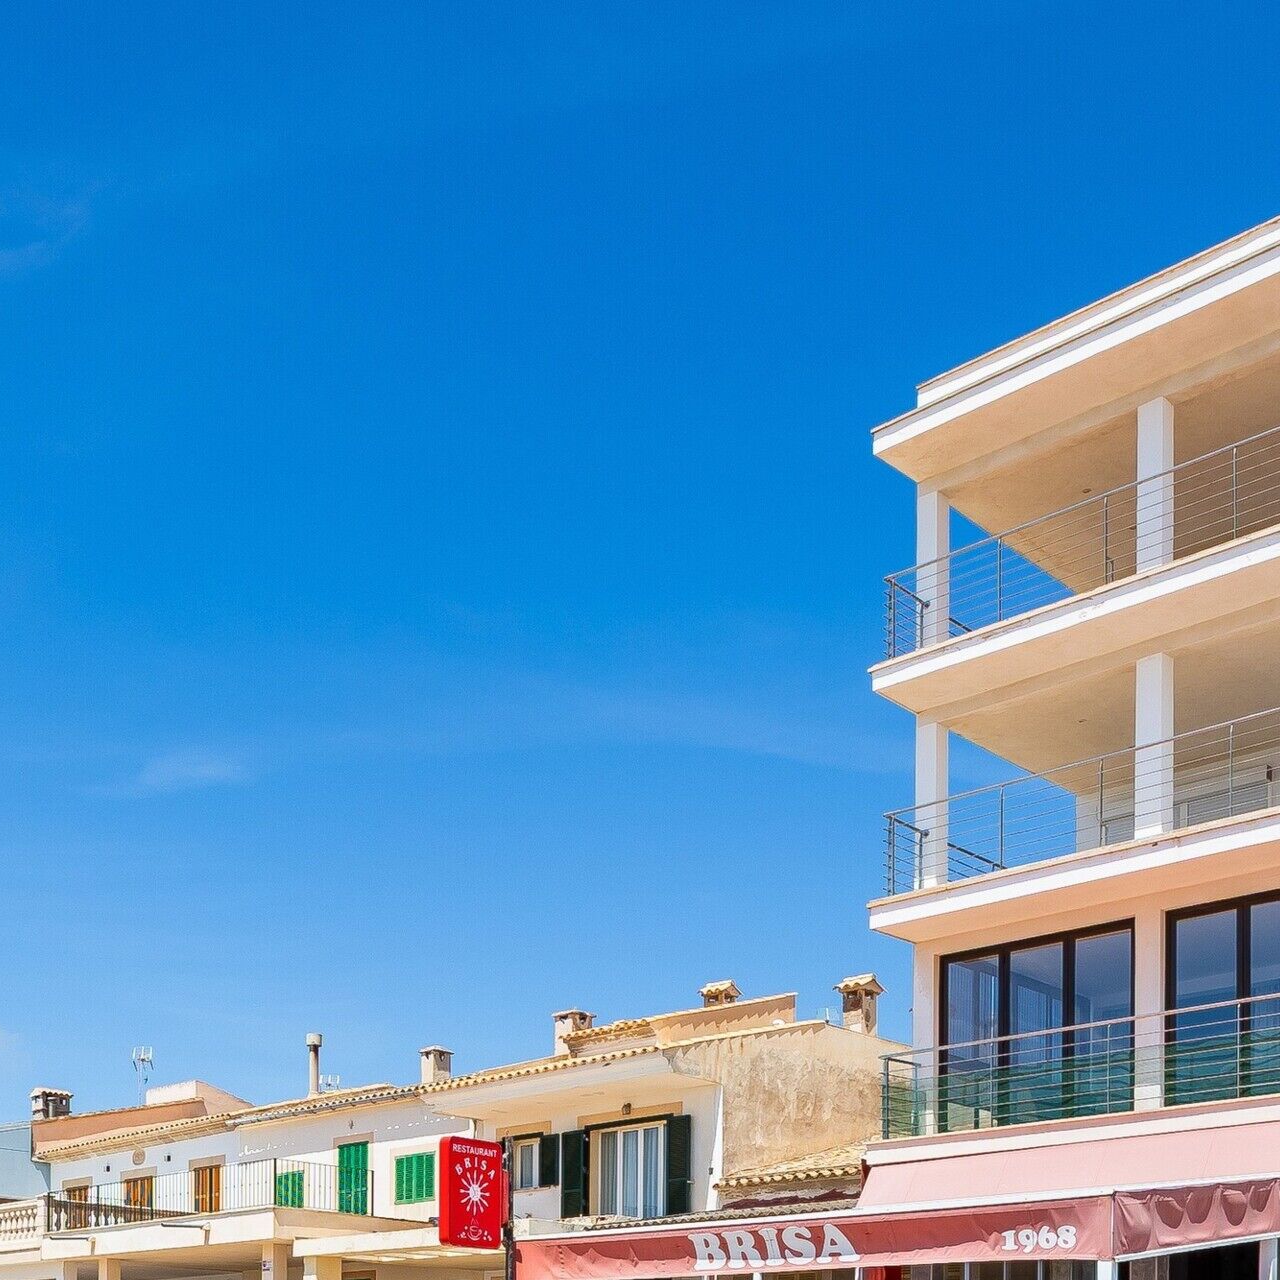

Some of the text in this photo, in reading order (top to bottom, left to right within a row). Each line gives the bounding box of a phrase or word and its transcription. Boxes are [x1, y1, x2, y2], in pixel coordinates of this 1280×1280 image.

[452, 1143, 498, 1158] RESTAURANT
[455, 1156, 495, 1180] BRISA
[688, 1223, 861, 1271] BRISA
[1001, 1225, 1077, 1253] 1968
